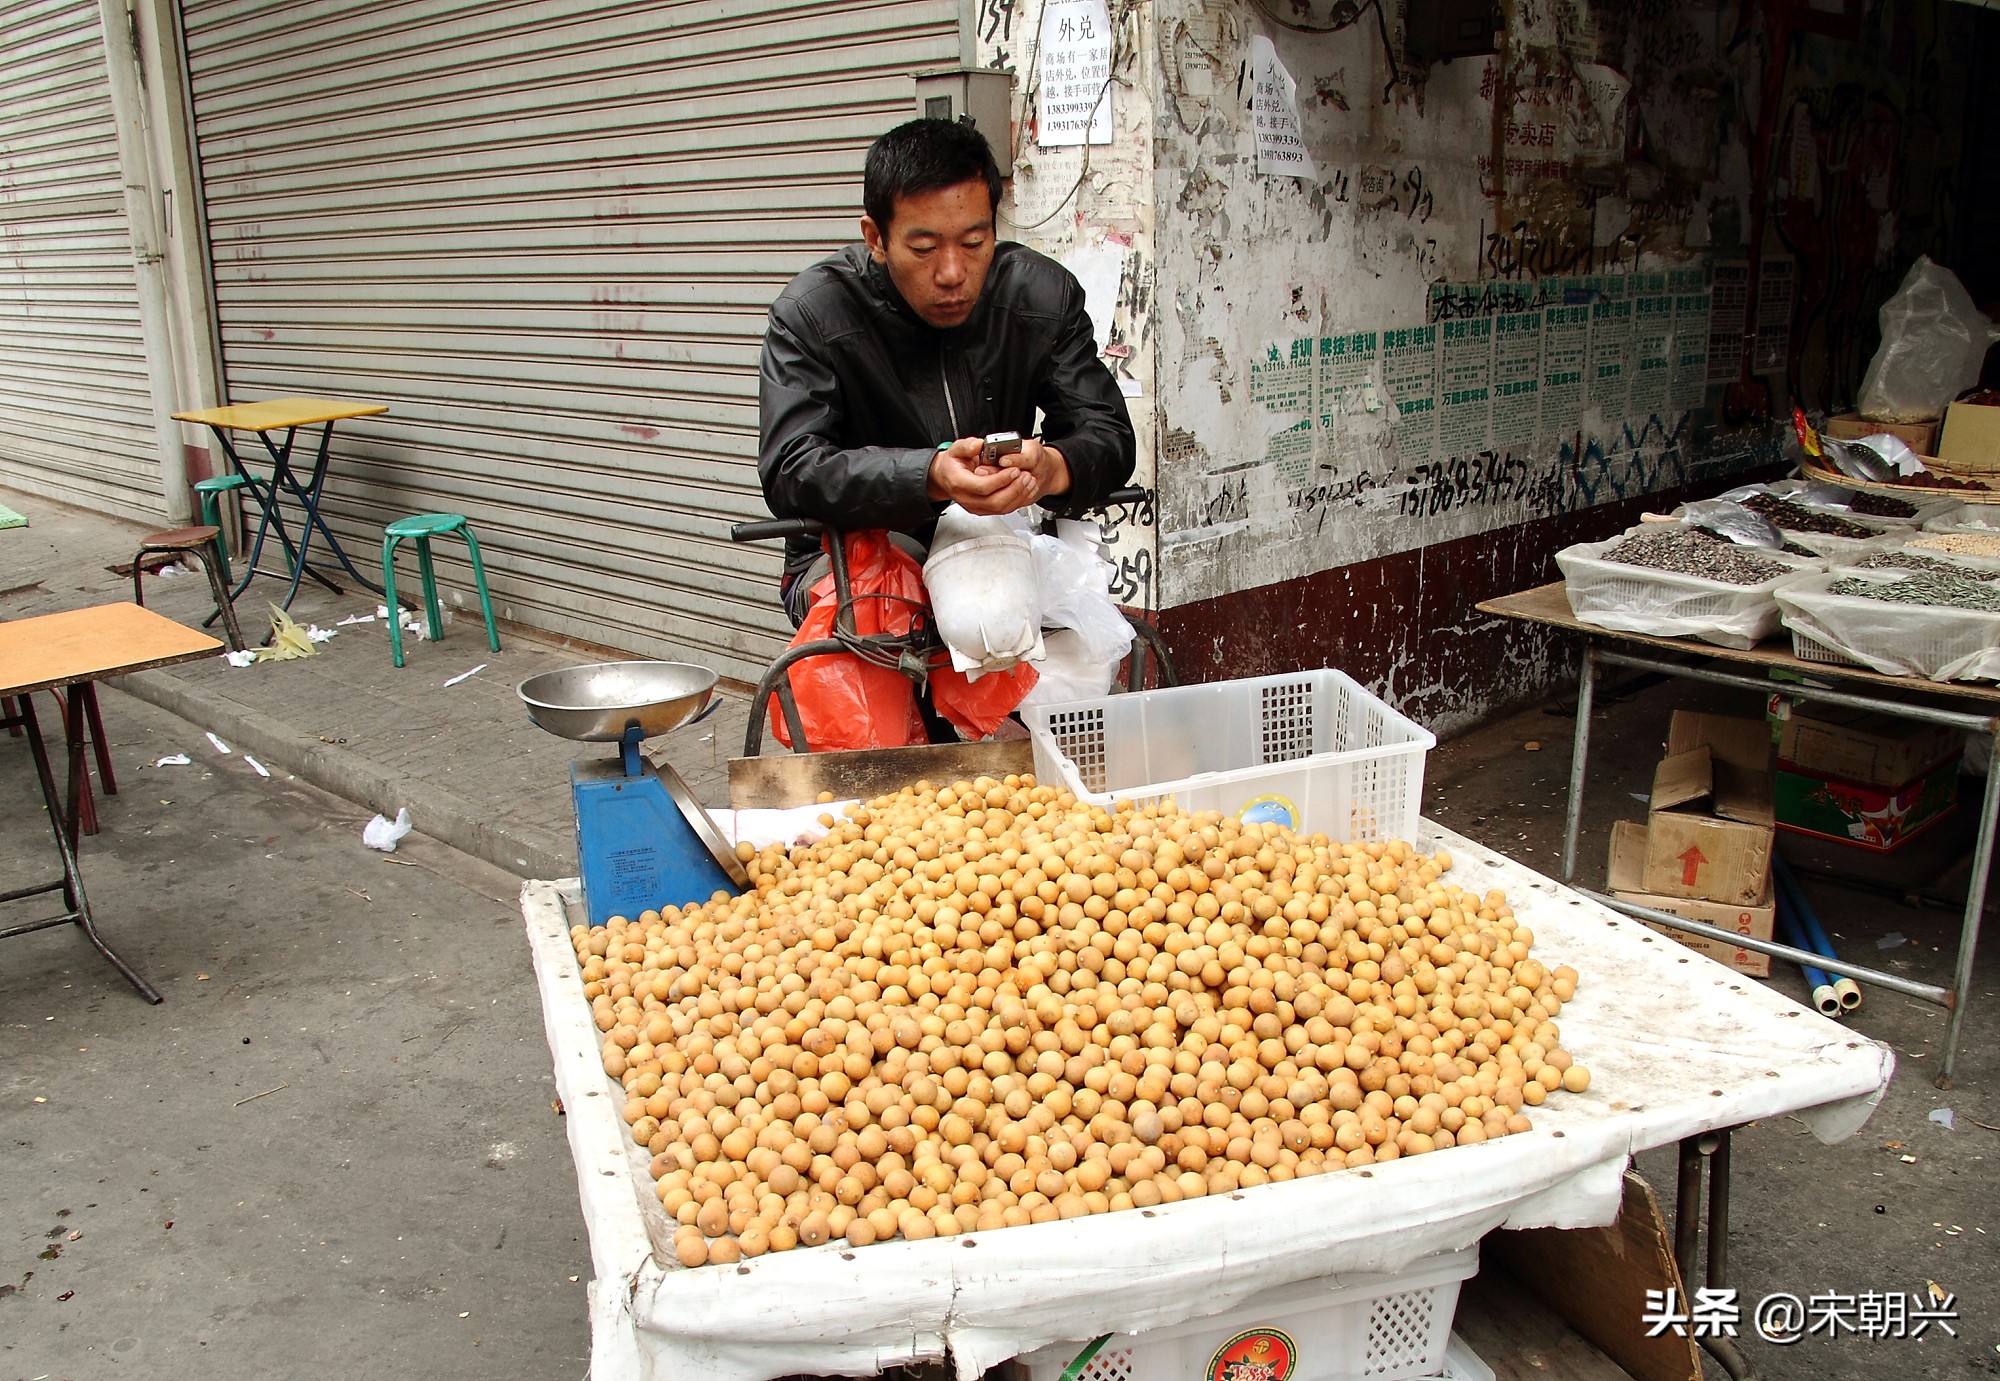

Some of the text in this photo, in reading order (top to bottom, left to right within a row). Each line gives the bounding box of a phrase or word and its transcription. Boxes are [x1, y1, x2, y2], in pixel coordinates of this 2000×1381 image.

[1058, 14, 1095, 42] 外兑
[1045, 47, 1108, 66] 商场有一家居
[1047, 119, 1098, 132] 1393176383
[1441, 387, 1489, 406] 万能麻将机
